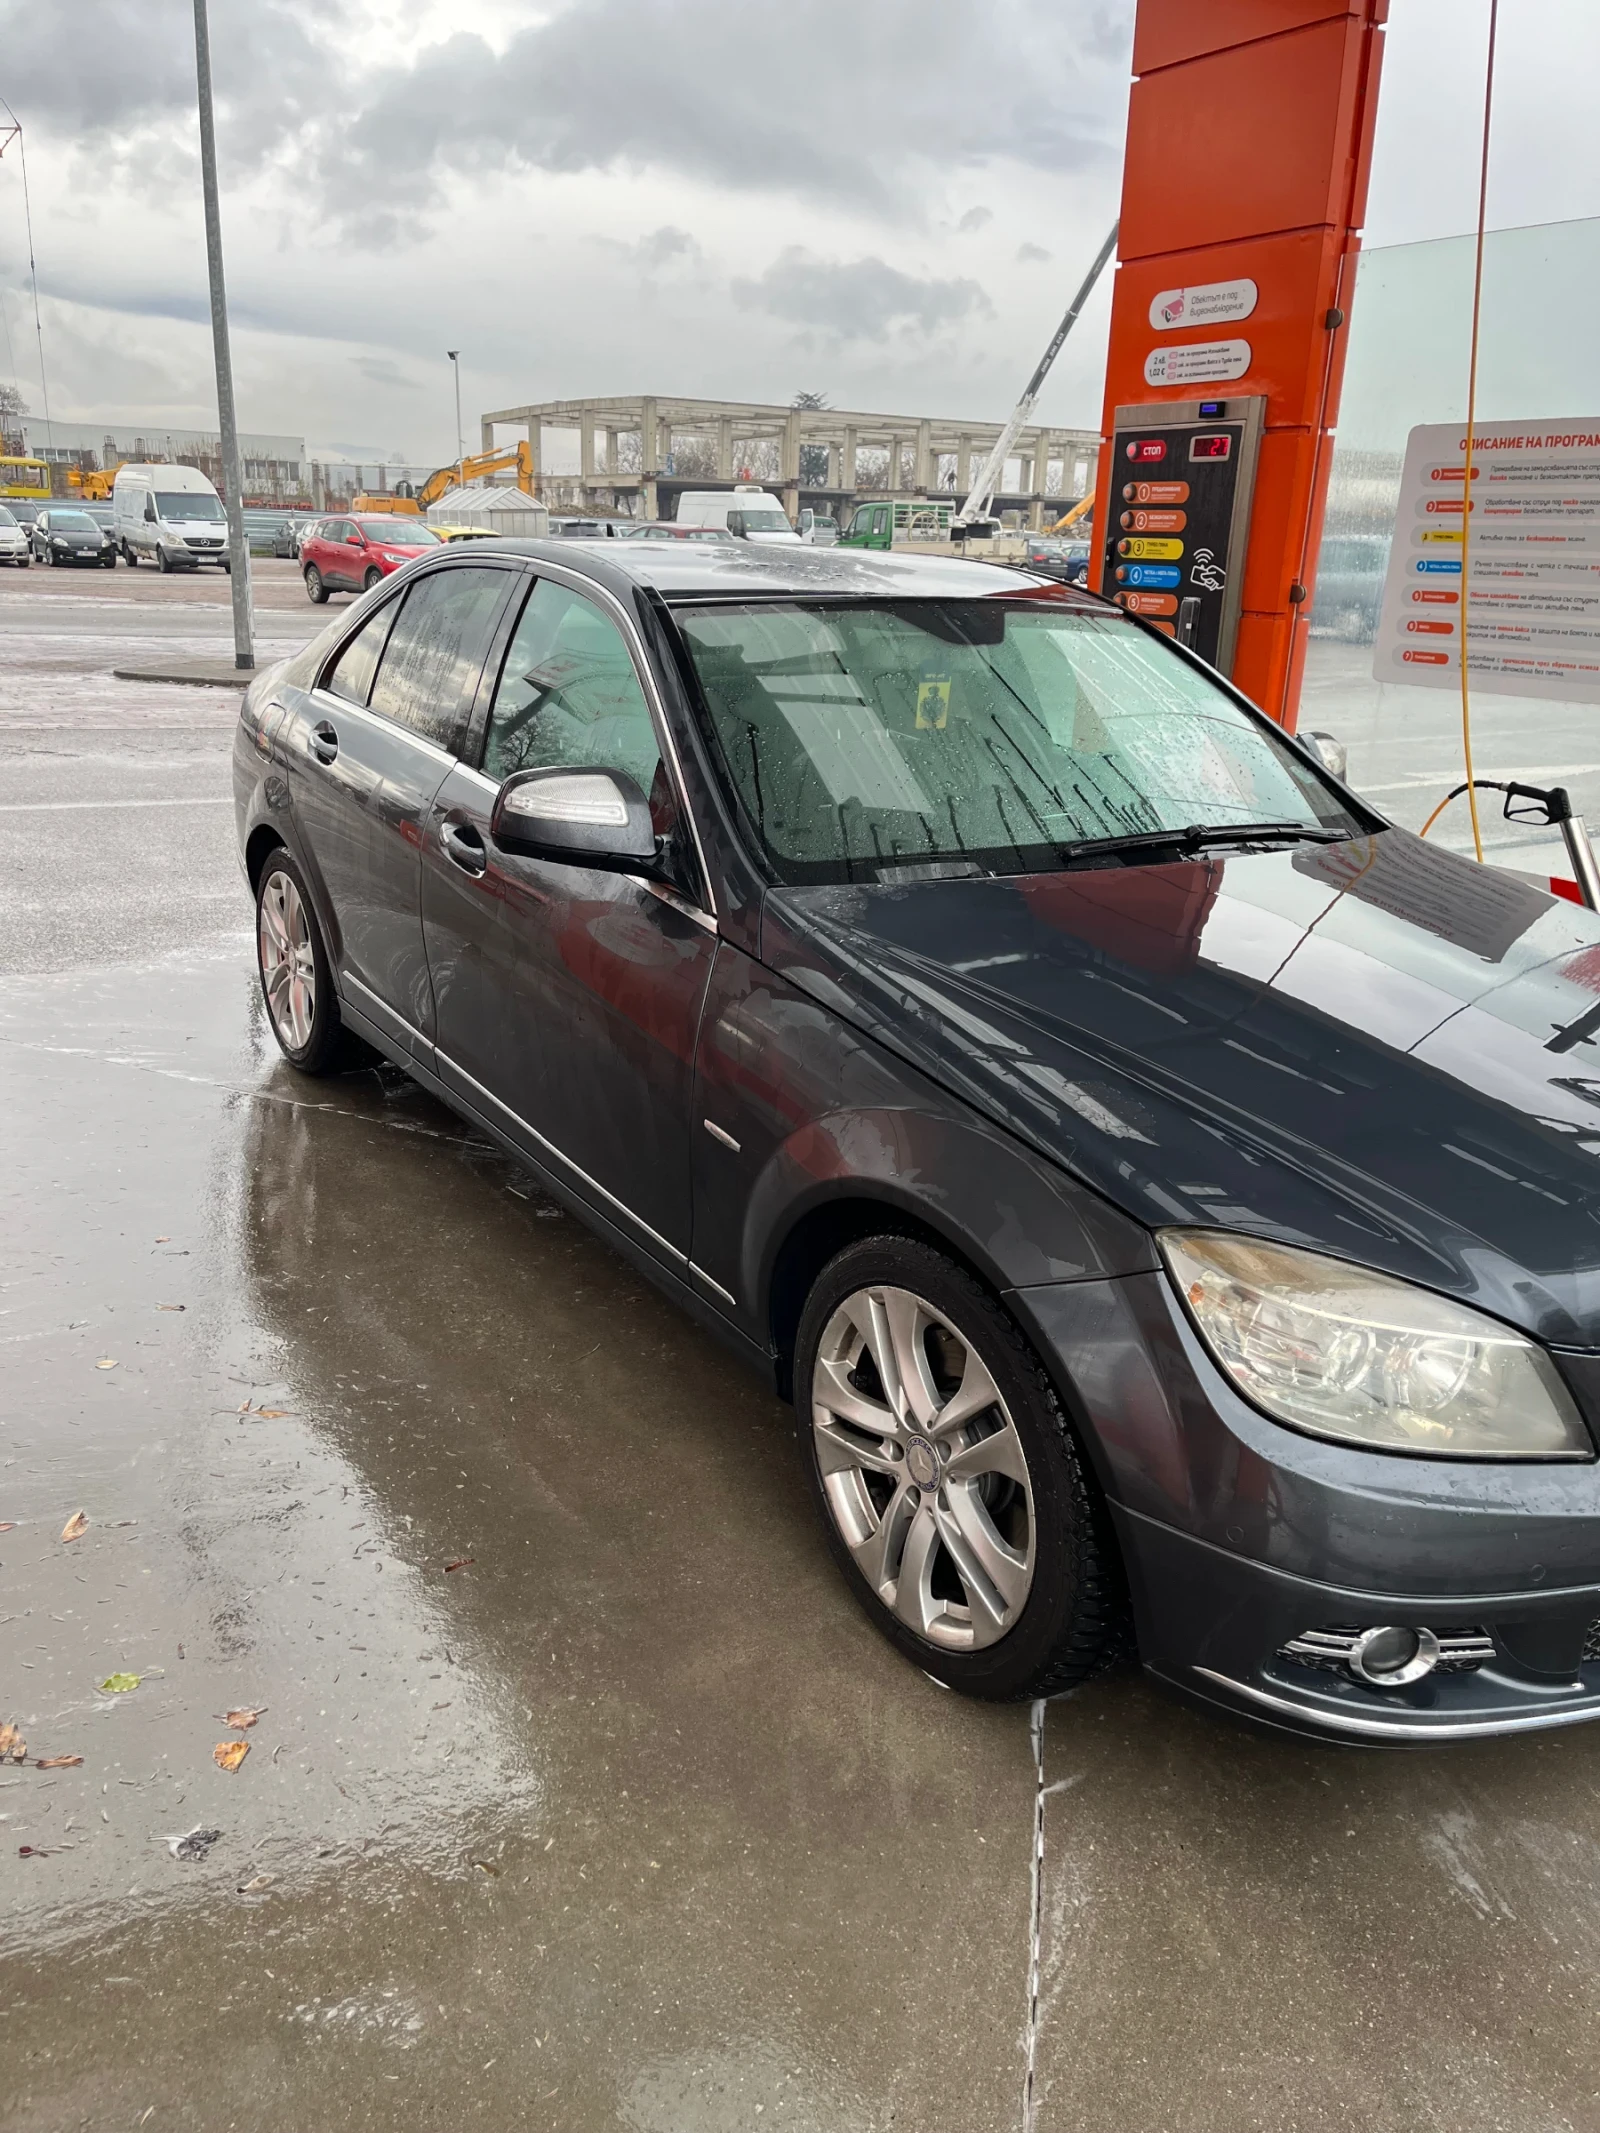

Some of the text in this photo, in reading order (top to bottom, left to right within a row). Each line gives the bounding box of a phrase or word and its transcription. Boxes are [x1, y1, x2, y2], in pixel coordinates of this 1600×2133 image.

[1227, 292, 1238, 301] под
[1153, 356, 1158, 365] 2
[1525, 436, 1542, 448] НА
[1143, 446, 1161, 455] СТОП
[1210, 438, 1229, 456] 27
